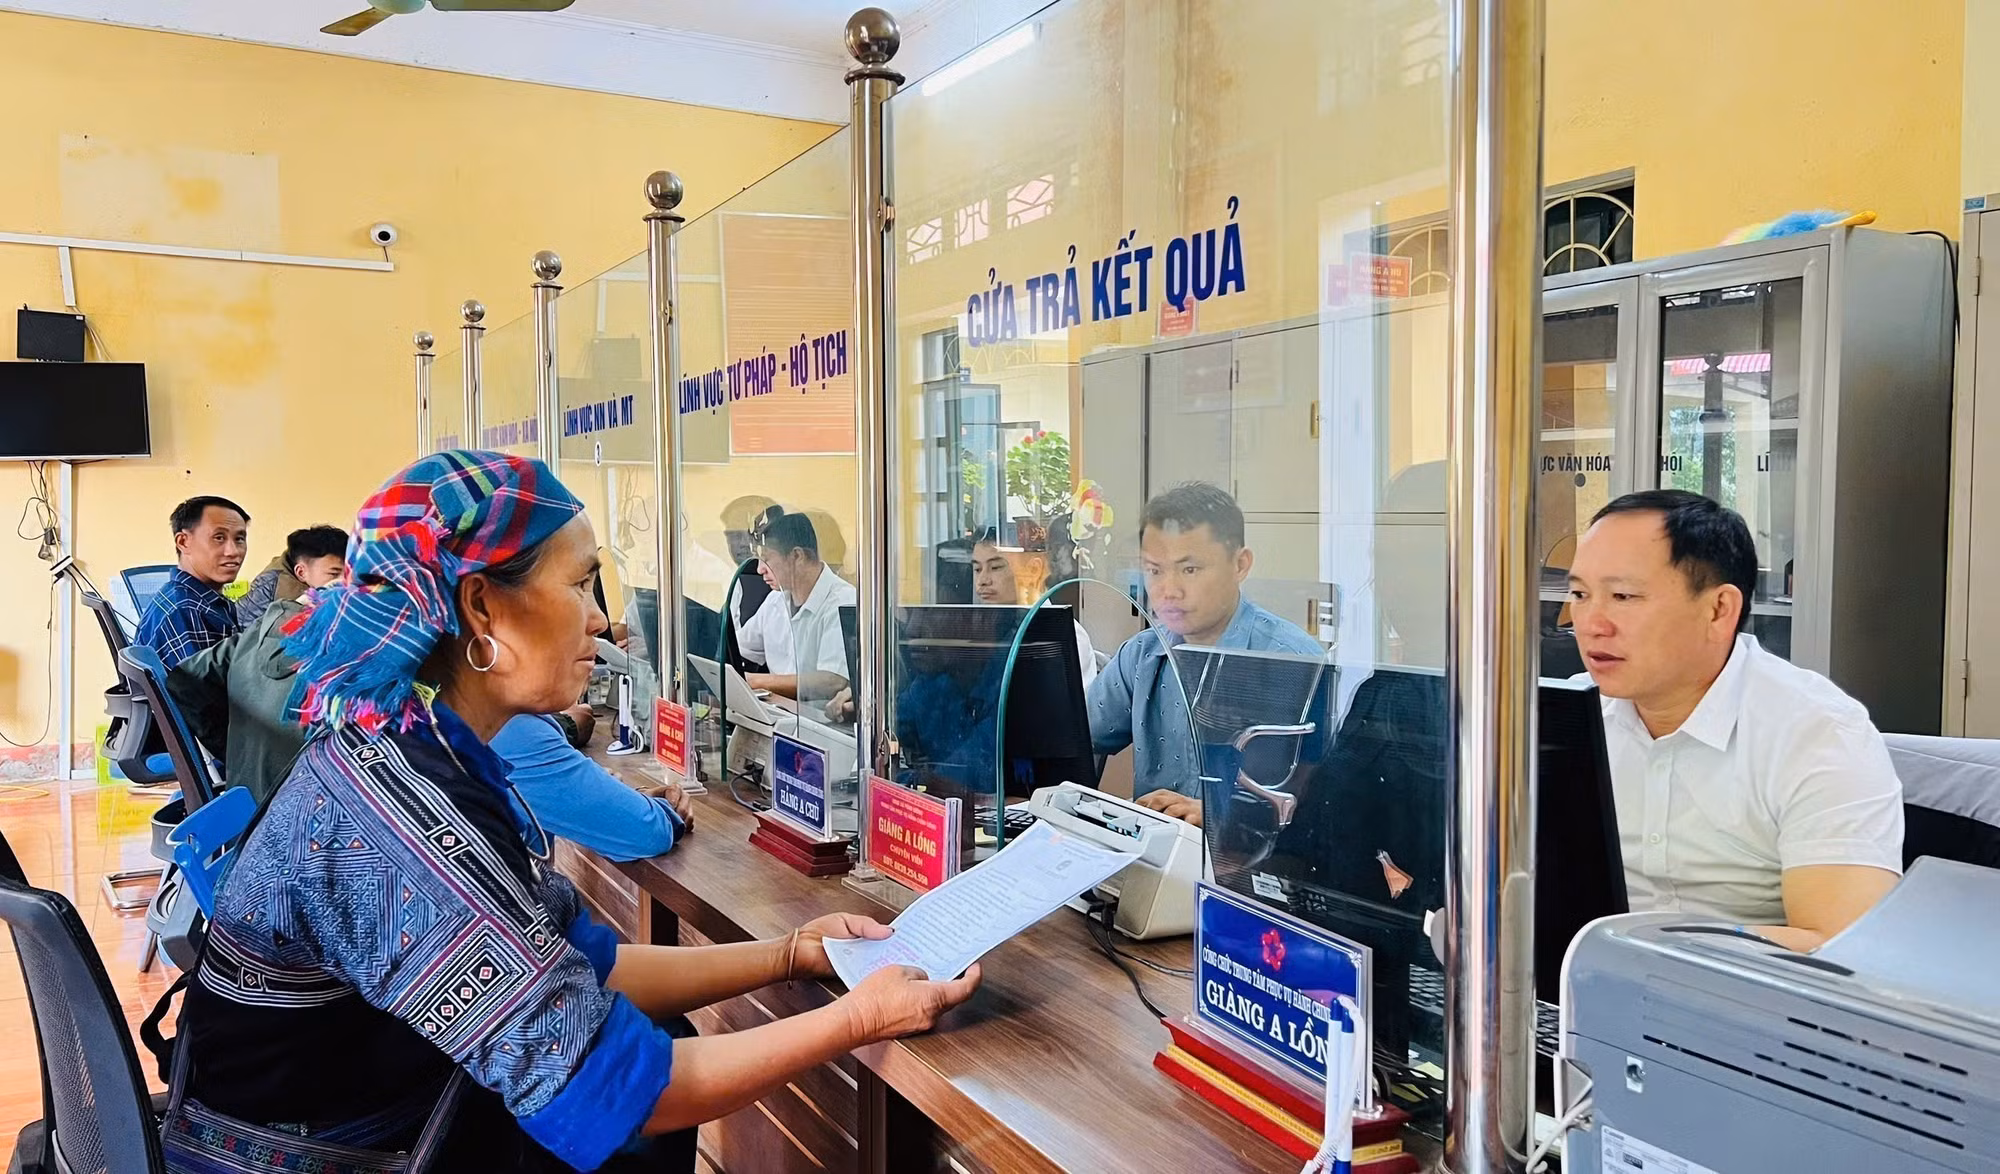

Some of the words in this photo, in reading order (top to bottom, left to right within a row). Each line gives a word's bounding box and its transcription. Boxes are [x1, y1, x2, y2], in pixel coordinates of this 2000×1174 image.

[967, 267, 1018, 347] CỬA
[1026, 244, 1081, 334] TRẢ
[1091, 229, 1153, 321] KẾT
[1165, 195, 1246, 313] QUẢ
[703, 367, 723, 415] VỰC
[727, 358, 742, 402] TƯ
[744, 346, 776, 398] PHÁP
[790, 333, 809, 394] HỘ
[812, 330, 847, 390] TỊCH
[608, 392, 618, 429] VÀ
[621, 395, 633, 426] MT
[1540, 455, 1554, 475] ỰC
[1558, 452, 1582, 472] VĂN
[1586, 452, 1611, 472] HÓA
[1660, 453, 1682, 476] HỘI
[799, 799, 805, 814] A
[904, 829, 911, 846] A
[1203, 944, 1217, 967] CÔNG
[1218, 953, 1232, 975] CHỨC
[1233, 961, 1252, 984] TRUNG
[1253, 968, 1266, 991] TÂM
[1266, 977, 1283, 1001] PHỤC
[1283, 986, 1292, 1008] VỤ
[1293, 988, 1311, 1014] HÀNH
[1206, 979, 1265, 1031] GIÀNG
[1269, 1014, 1284, 1042] A
[1288, 1016, 1329, 1067] LỒN
